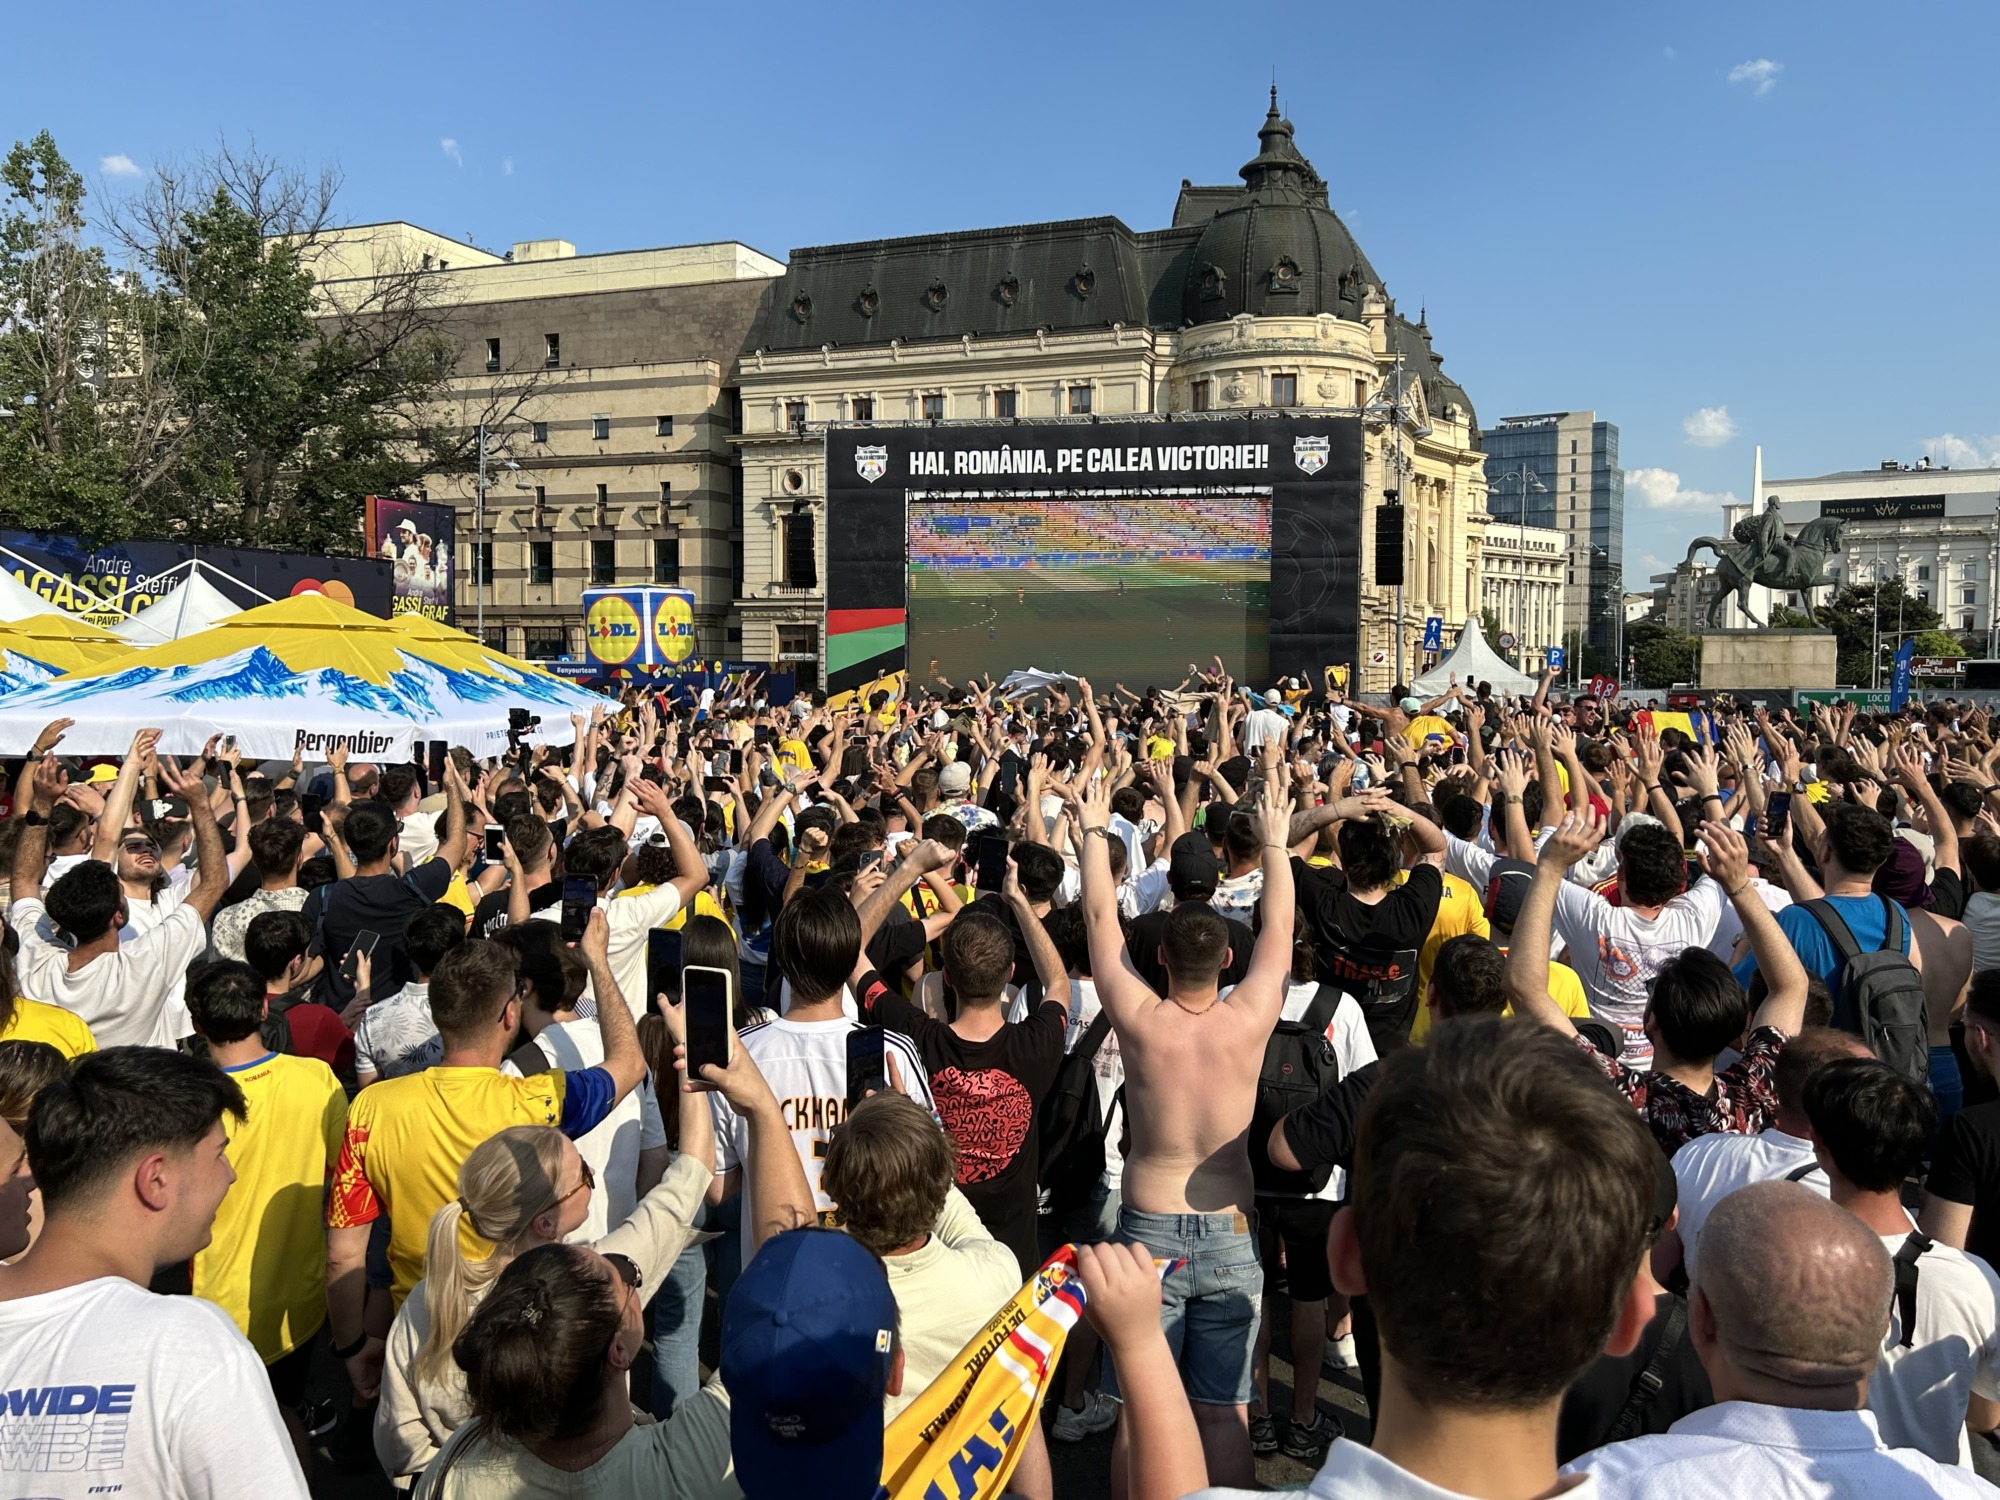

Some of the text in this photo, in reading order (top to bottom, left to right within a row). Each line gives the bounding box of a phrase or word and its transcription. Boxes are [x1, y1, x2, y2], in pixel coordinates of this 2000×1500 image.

[909, 444, 1269, 476] HAI, ROMÂNIA, PE CALEA VICTORIEI!
[1825, 503, 1942, 514] PRINCESS CASINO
[84, 554, 131, 575] Andre
[134, 574, 179, 595] Steffi
[1551, 651, 1560, 662] P
[557, 666, 597, 675] #onyourteam
[1867, 694, 1882, 702] LOC
[1003, 1300, 1018, 1317] DIN
[1008, 1307, 1027, 1333] DE
